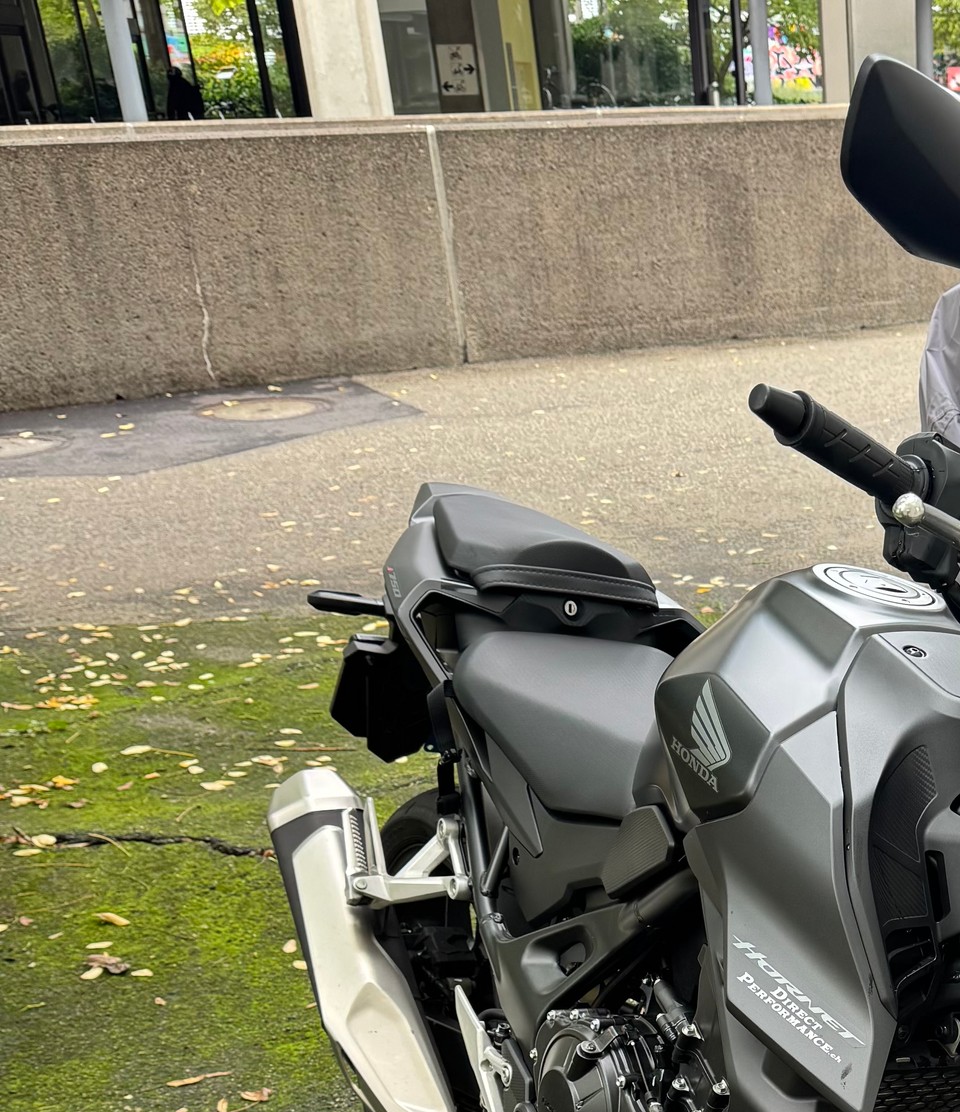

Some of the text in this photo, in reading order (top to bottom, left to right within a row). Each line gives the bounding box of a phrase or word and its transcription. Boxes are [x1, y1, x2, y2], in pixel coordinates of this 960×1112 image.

[671, 736, 719, 793] HONDA
[732, 934, 866, 1047] HORNET
[770, 986, 823, 1031] DIRECT
